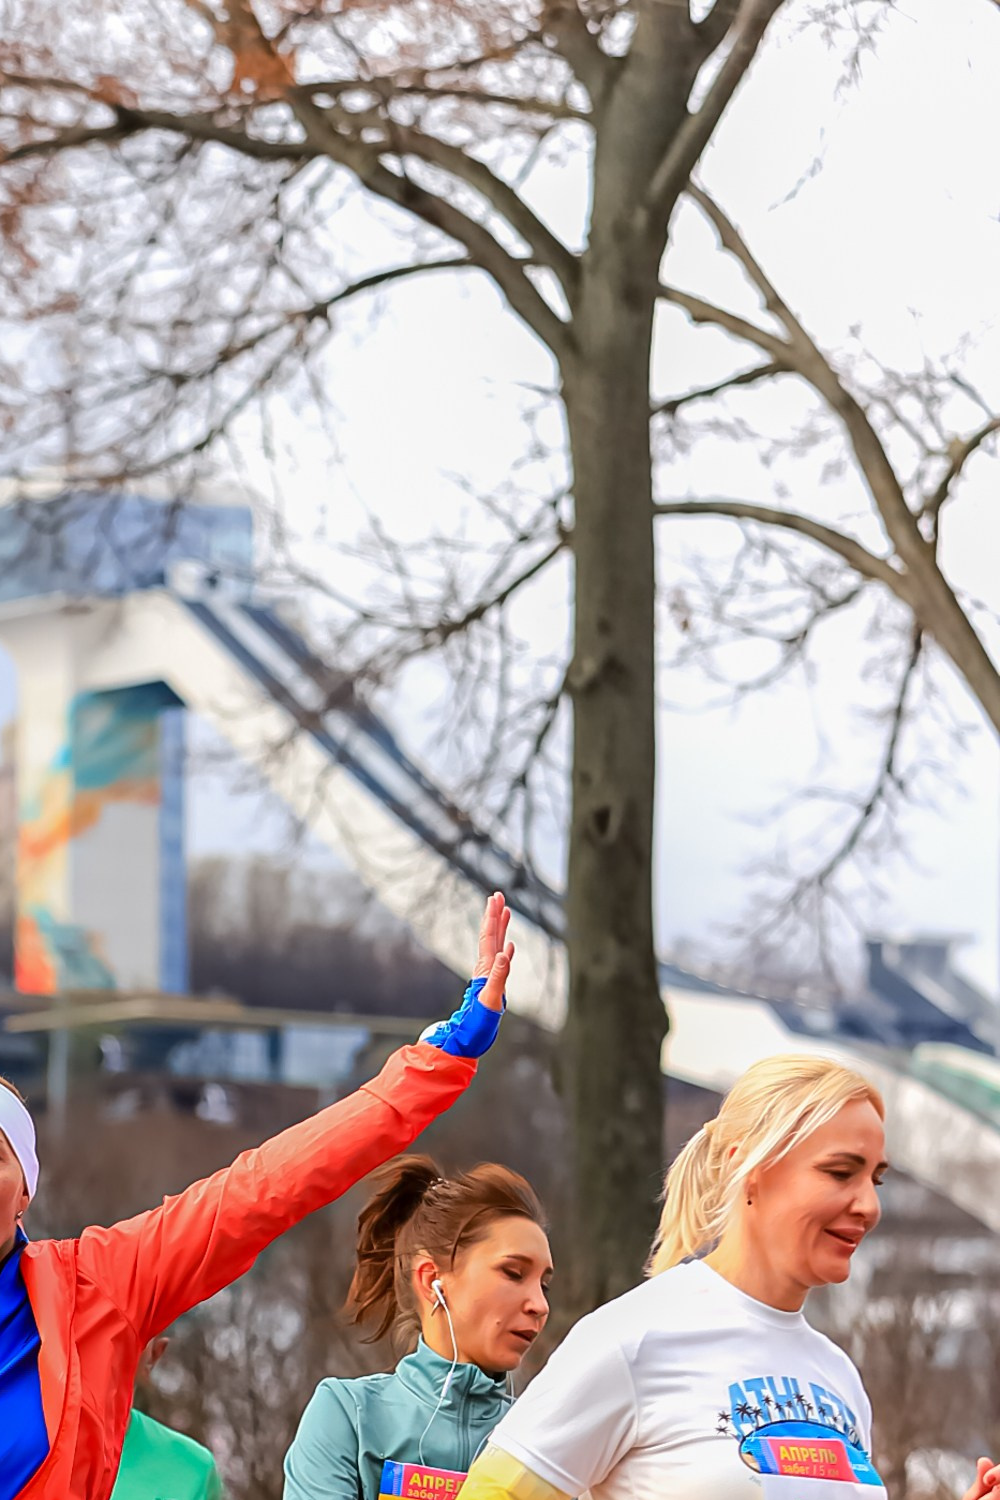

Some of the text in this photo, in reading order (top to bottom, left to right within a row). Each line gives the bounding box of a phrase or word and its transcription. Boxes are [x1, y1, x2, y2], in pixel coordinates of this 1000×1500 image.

[779, 1445, 838, 1464] АПРЕЛЬ
[782, 1462, 810, 1474] забег
[820, 1465, 825, 1476] 5
[407, 1488, 439, 1500] забег
